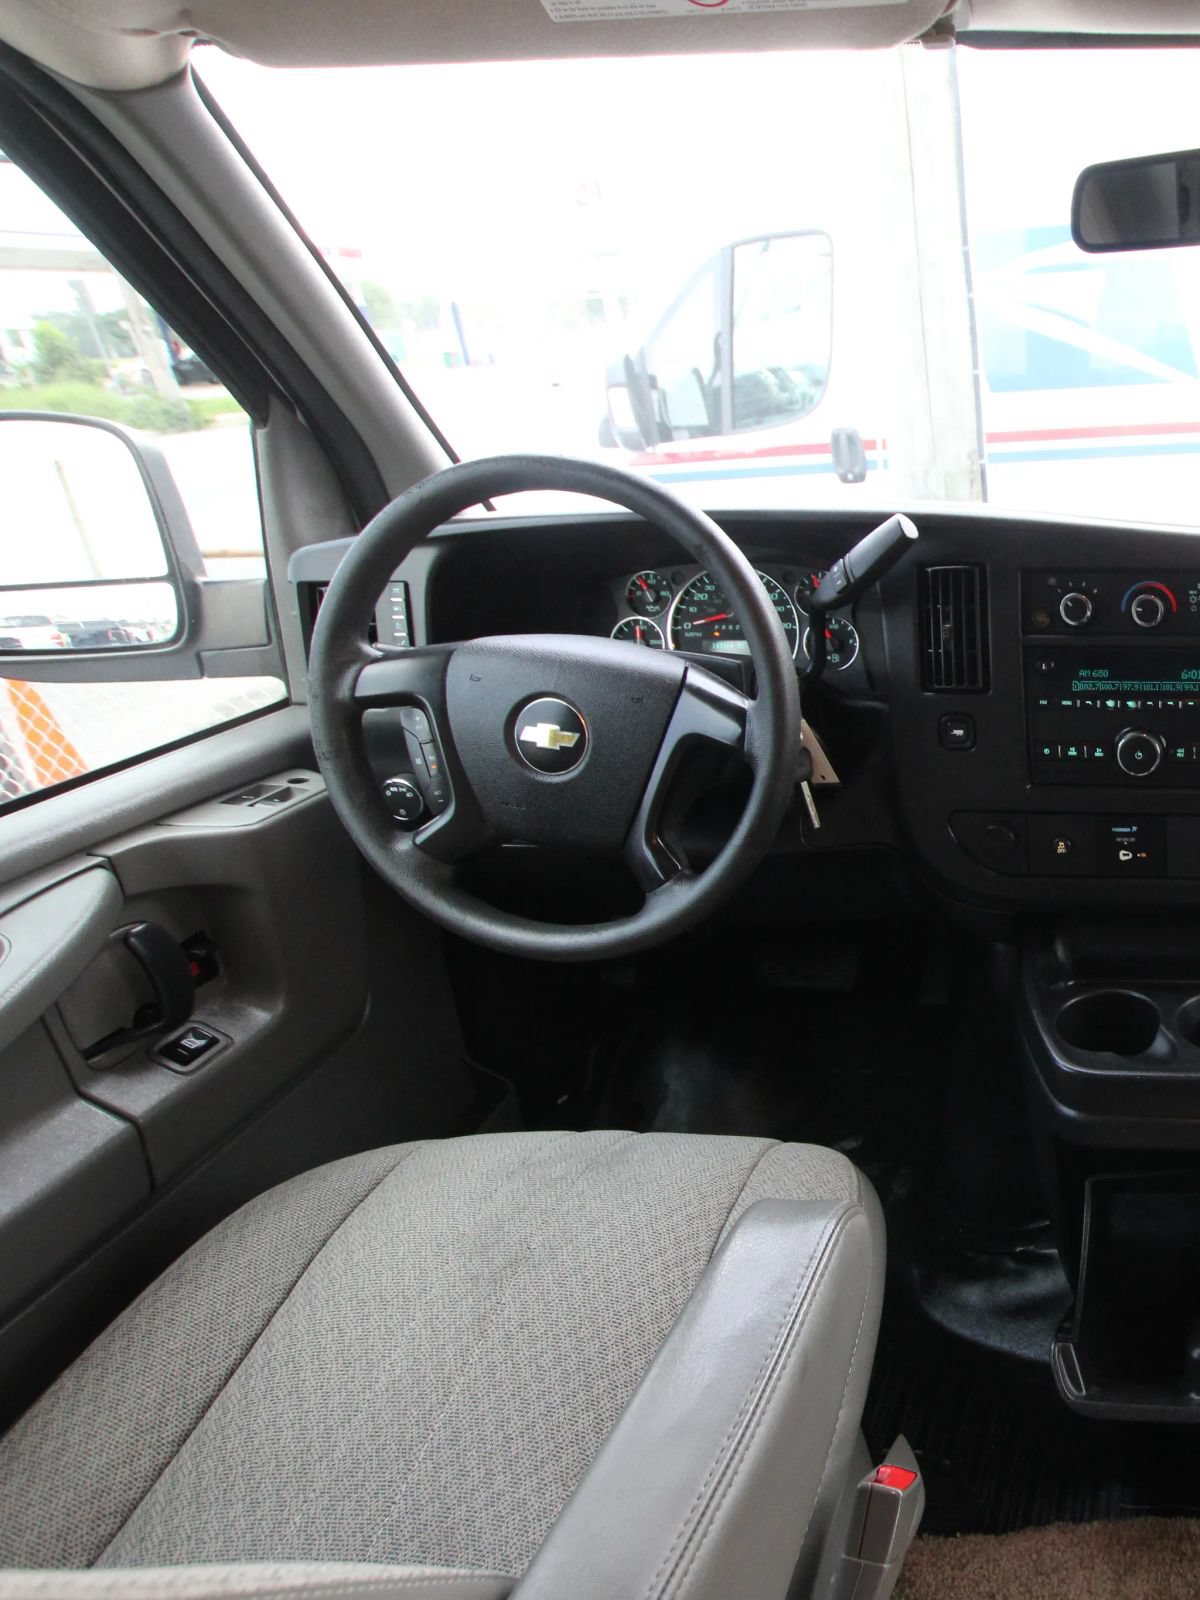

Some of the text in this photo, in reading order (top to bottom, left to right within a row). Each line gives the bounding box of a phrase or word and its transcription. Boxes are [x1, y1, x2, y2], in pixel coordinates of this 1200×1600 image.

[694, 593, 708, 601] 20
[684, 622, 692, 630] 0
[1079, 670, 1091, 678] AM
[1081, 683, 1100, 691] 102.7
